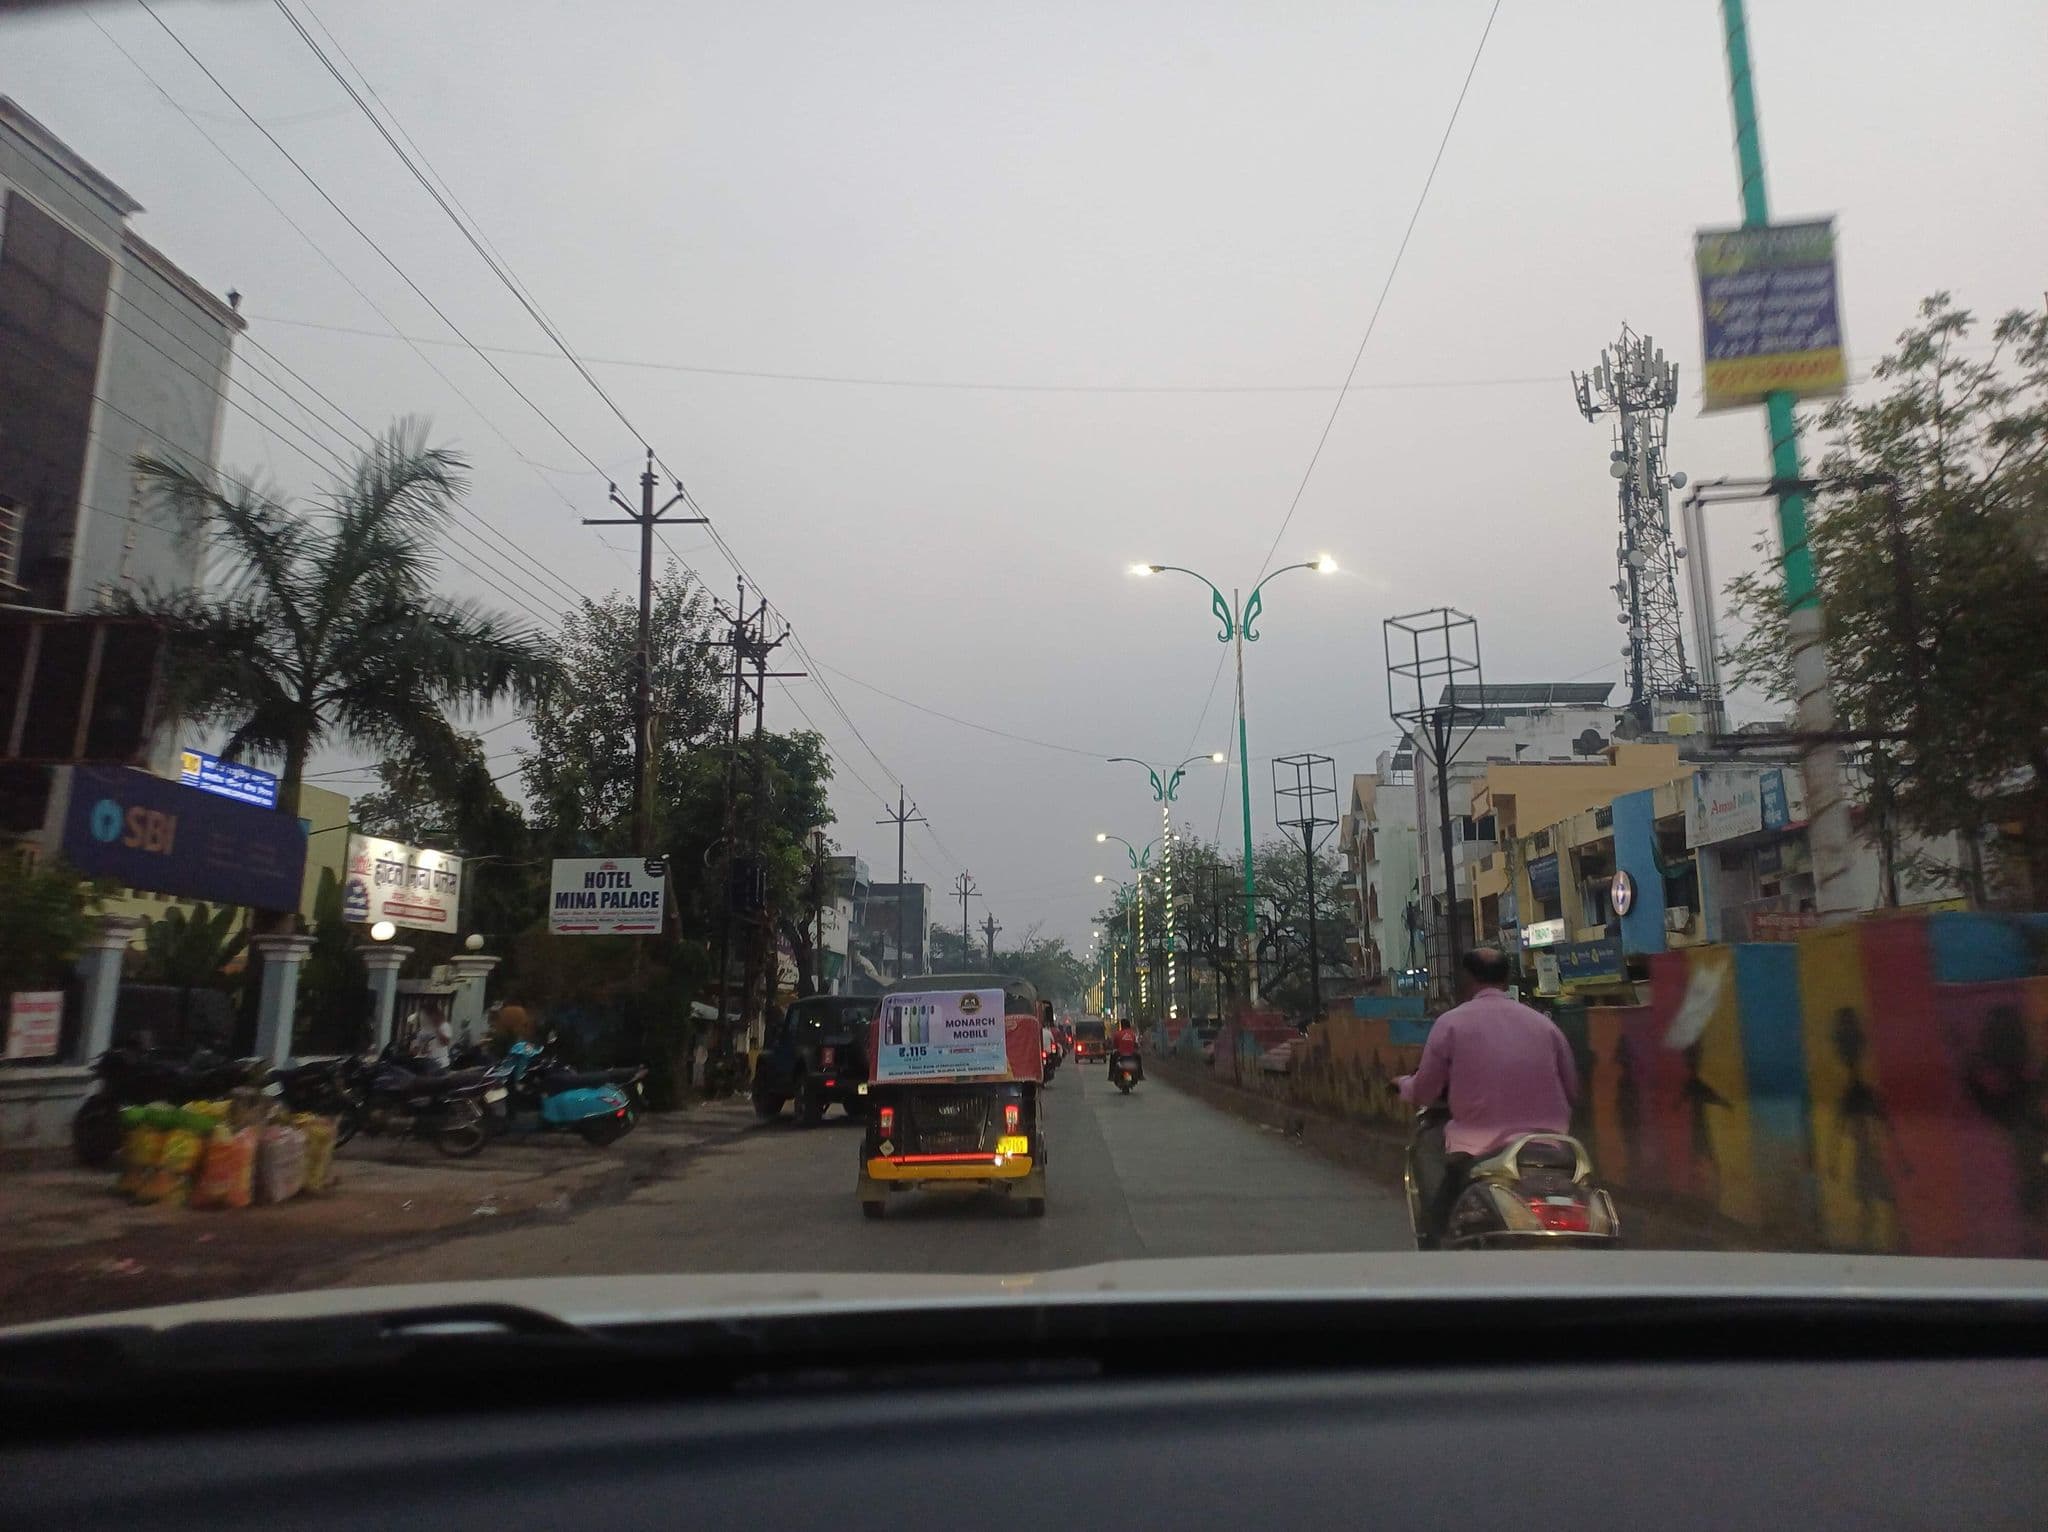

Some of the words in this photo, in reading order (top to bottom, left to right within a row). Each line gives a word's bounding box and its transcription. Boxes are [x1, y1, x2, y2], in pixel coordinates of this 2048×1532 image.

[124, 806, 178, 856] SBI
[584, 871, 632, 888] HOTEL
[555, 891, 597, 909] MINA
[601, 891, 660, 909] PALACE
[945, 1018, 996, 1028] MONARCH
[953, 1030, 988, 1040] MOBILE
